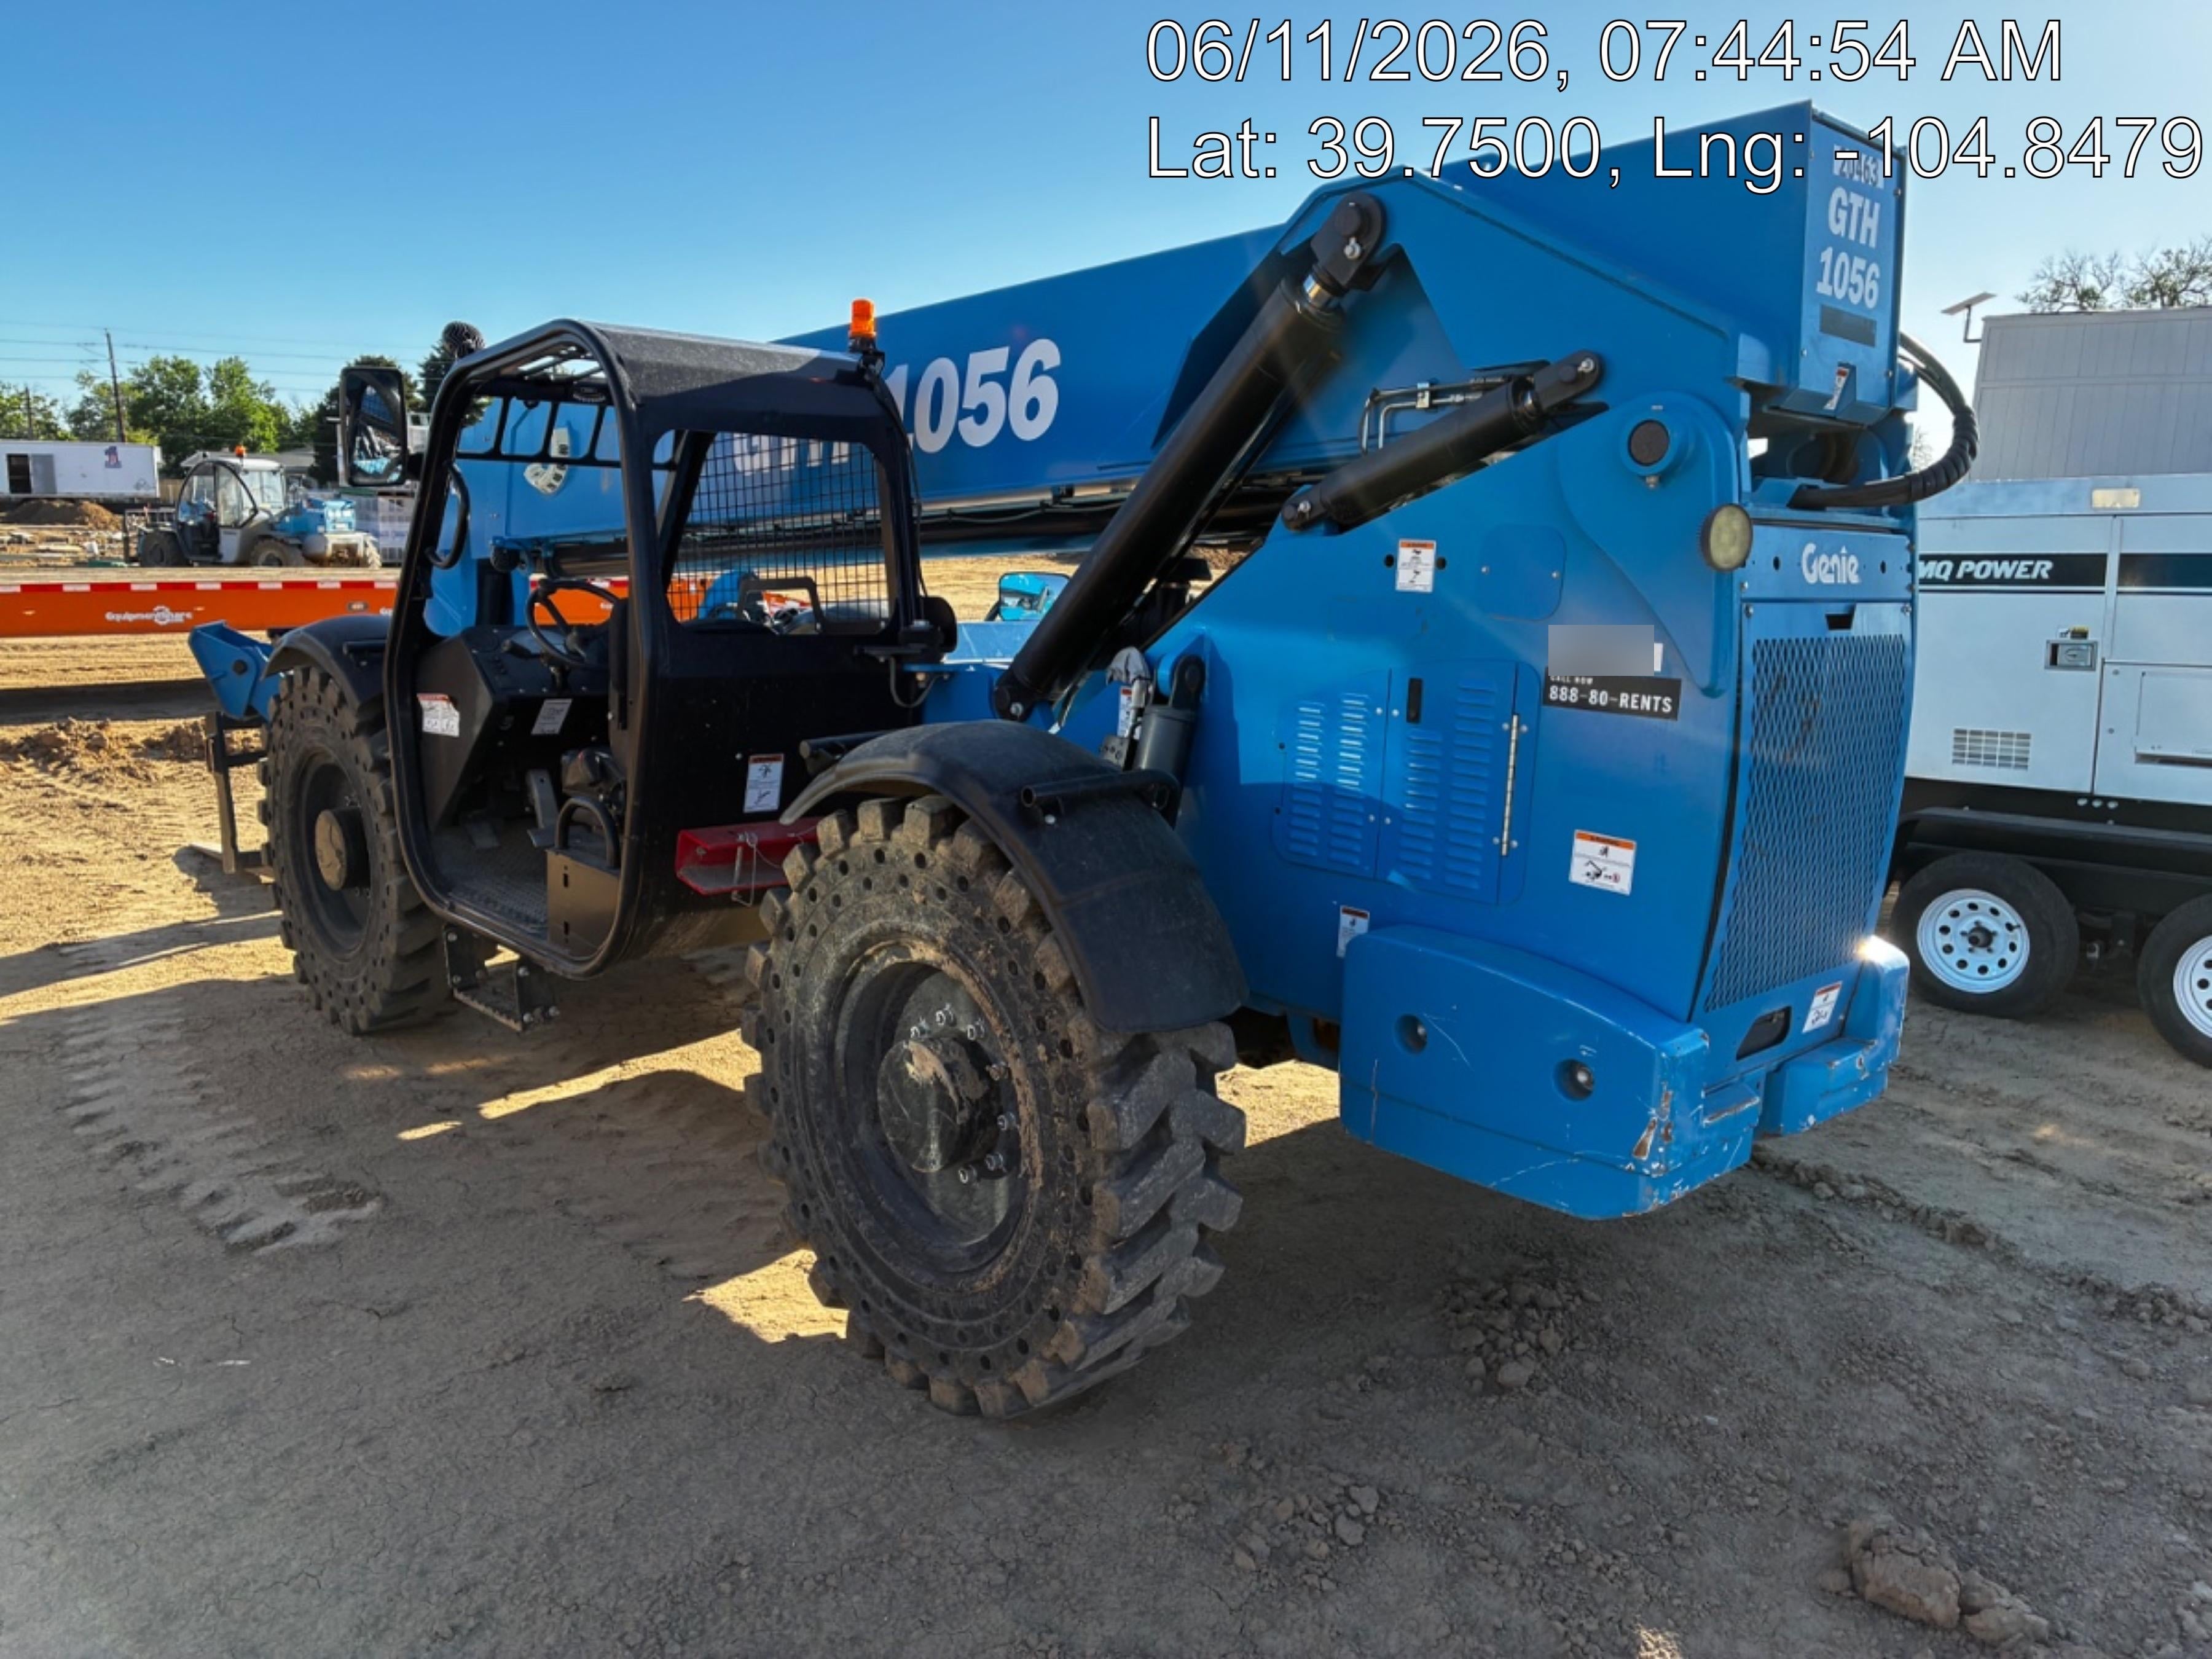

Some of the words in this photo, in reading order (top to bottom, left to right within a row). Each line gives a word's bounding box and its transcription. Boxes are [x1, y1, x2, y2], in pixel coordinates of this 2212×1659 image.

[1829, 187, 1880, 248] GTH
[1816, 246, 1880, 309] 1056
[1802, 543, 1859, 584] Genie
[1919, 560, 1954, 581] MQ
[1956, 559, 2053, 580] POWER
[1548, 685, 1673, 713] 888-80-RENTS
